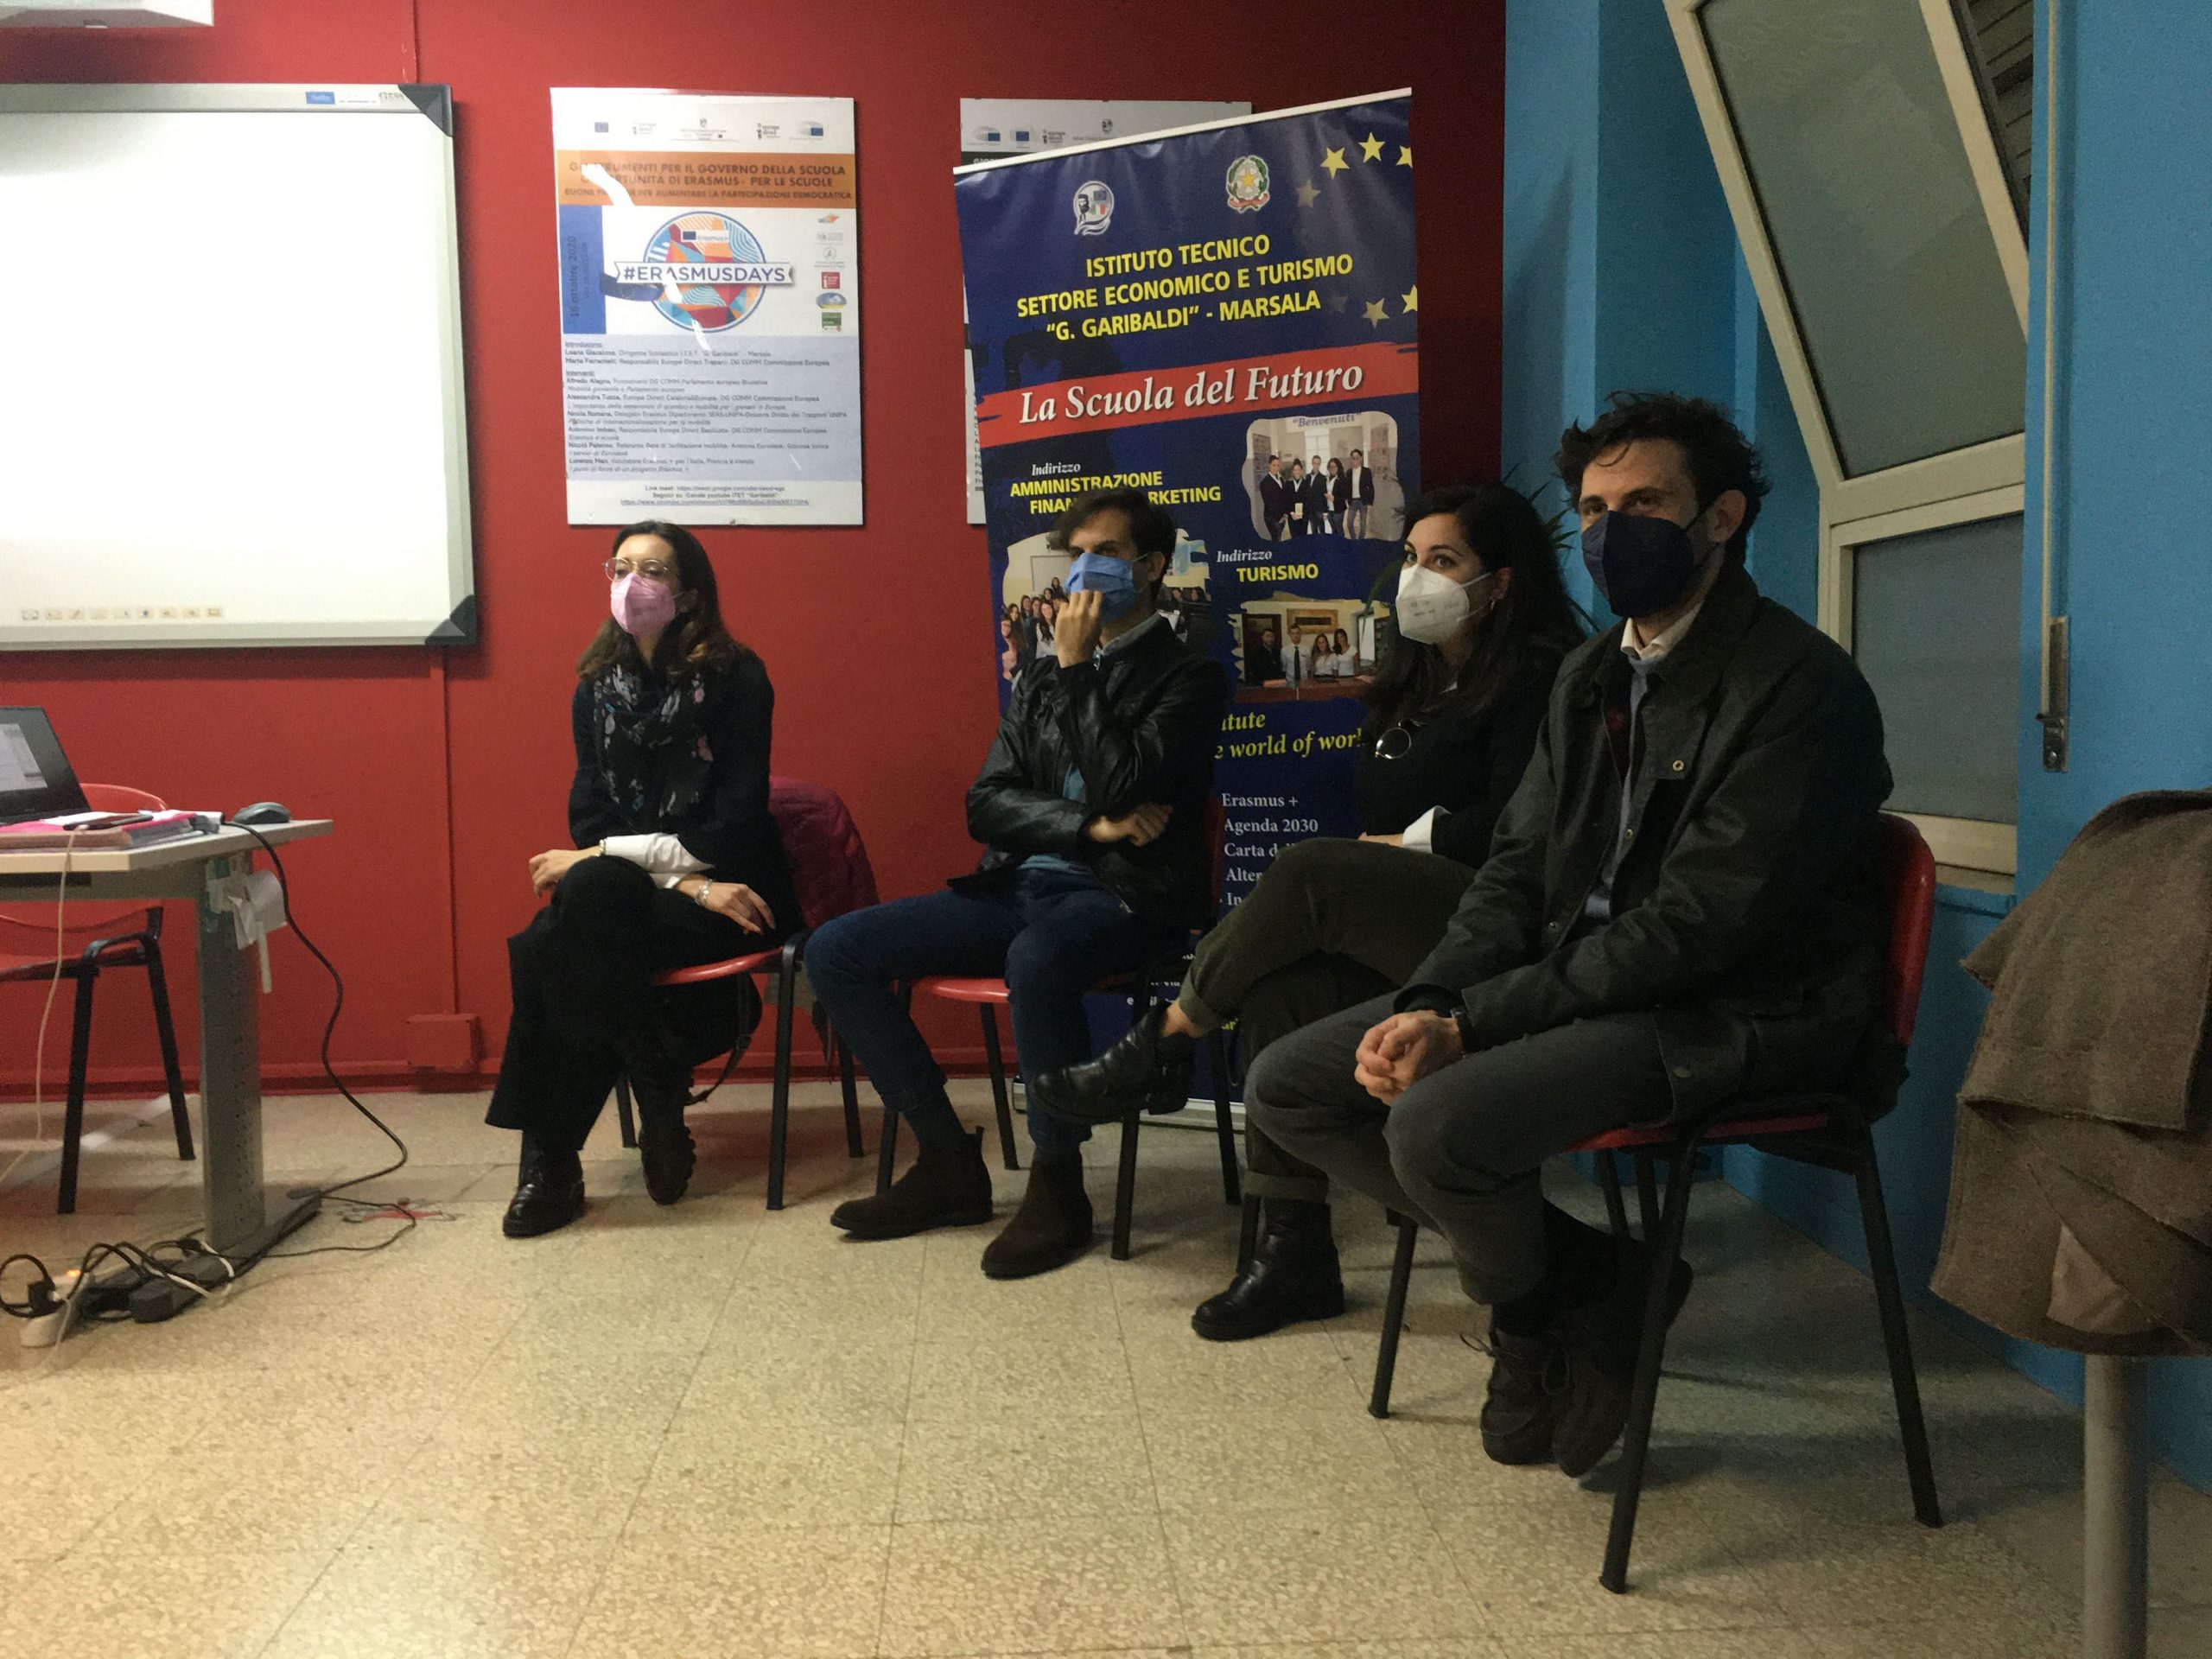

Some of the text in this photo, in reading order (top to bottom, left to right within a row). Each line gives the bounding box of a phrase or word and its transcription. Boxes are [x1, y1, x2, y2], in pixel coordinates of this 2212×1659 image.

[661, 163, 681, 172] PER
[685, 163, 695, 173] IL
[698, 164, 759, 174] GOVERNO
[761, 165, 796, 175] DELLA
[799, 166, 846, 175] SCUOLA
[669, 175, 680, 184] DI
[750, 177, 771, 186] PER
[774, 177, 785, 186] LE
[790, 177, 833, 187] SCUOLE
[1086, 234, 1270, 277] ISTITUTO TECNICO
[623, 266, 785, 282] #ERASMUSDAYS
[1017, 254, 1353, 317] SETTORE ECONOMICO E TURISMO
[1082, 305, 1199, 338] GARIBALDI”
[1219, 289, 1321, 321] MARSALA
[1020, 364, 1364, 424] La Scuola del Futuro
[1031, 461, 1081, 476] Indirizzo
[1009, 471, 1163, 497] AMMINISTRAZIONE
[1147, 486, 1222, 505] RKETING
[1217, 548, 1272, 563] Indirizzo
[1236, 563, 1319, 583] TURISMO
[1230, 734, 1287, 755] world
[1293, 731, 1315, 758] of
[1221, 793, 1299, 807] Erasmus +
[1224, 819, 1319, 834] Agenda 2030
[1224, 843, 1265, 857] Carta
